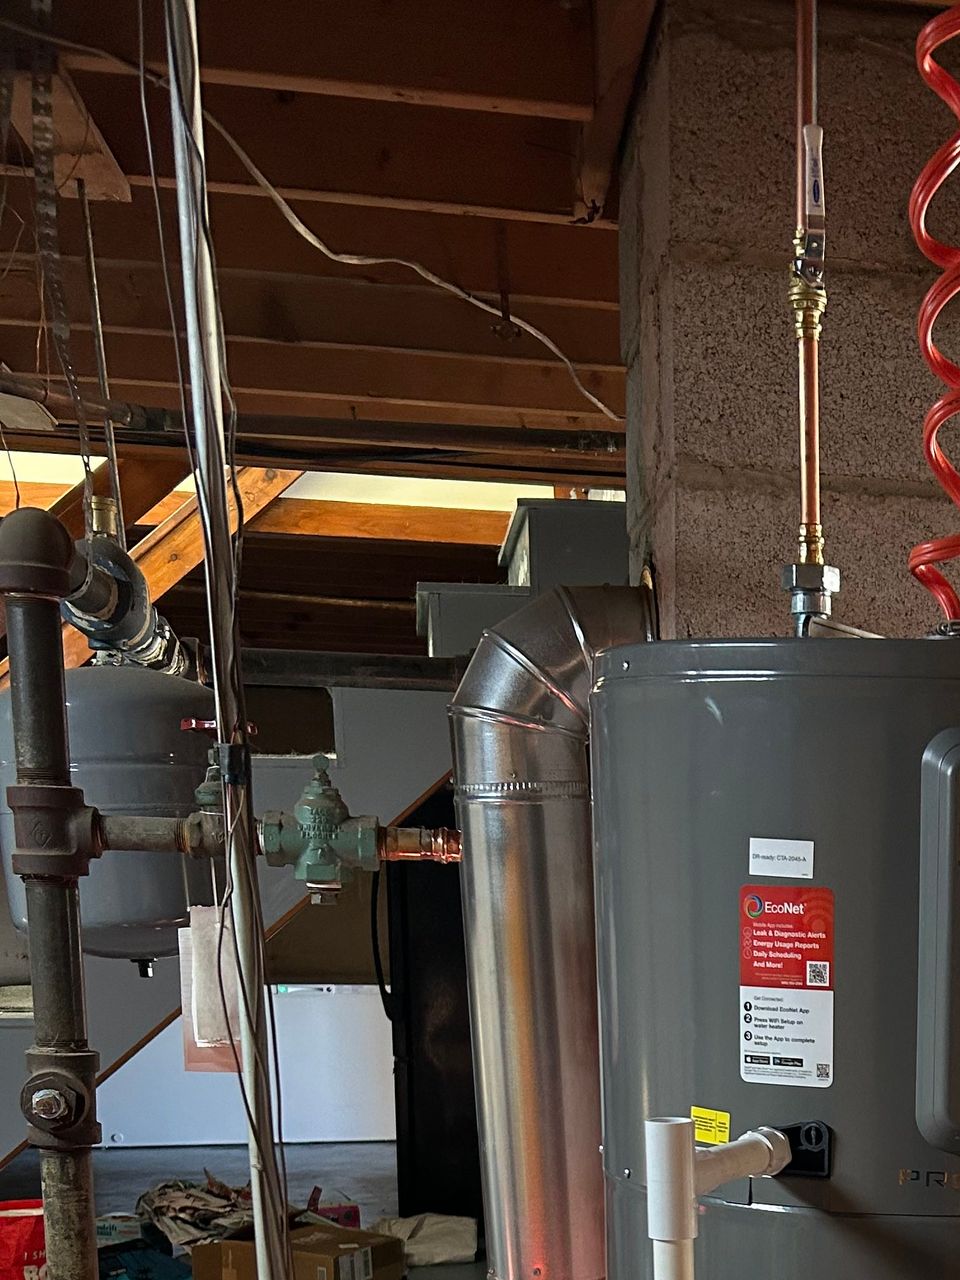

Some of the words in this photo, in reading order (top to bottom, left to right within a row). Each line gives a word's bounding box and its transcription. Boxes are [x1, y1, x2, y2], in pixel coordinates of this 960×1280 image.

[764, 901, 805, 915] EcoNet
[774, 930, 806, 938] Diagnostic
[807, 931, 826, 939] Alerts
[753, 940, 773, 948] Energy
[775, 940, 794, 949] Usage
[753, 950, 767, 958] Daily
[769, 951, 802, 960] Scheduling
